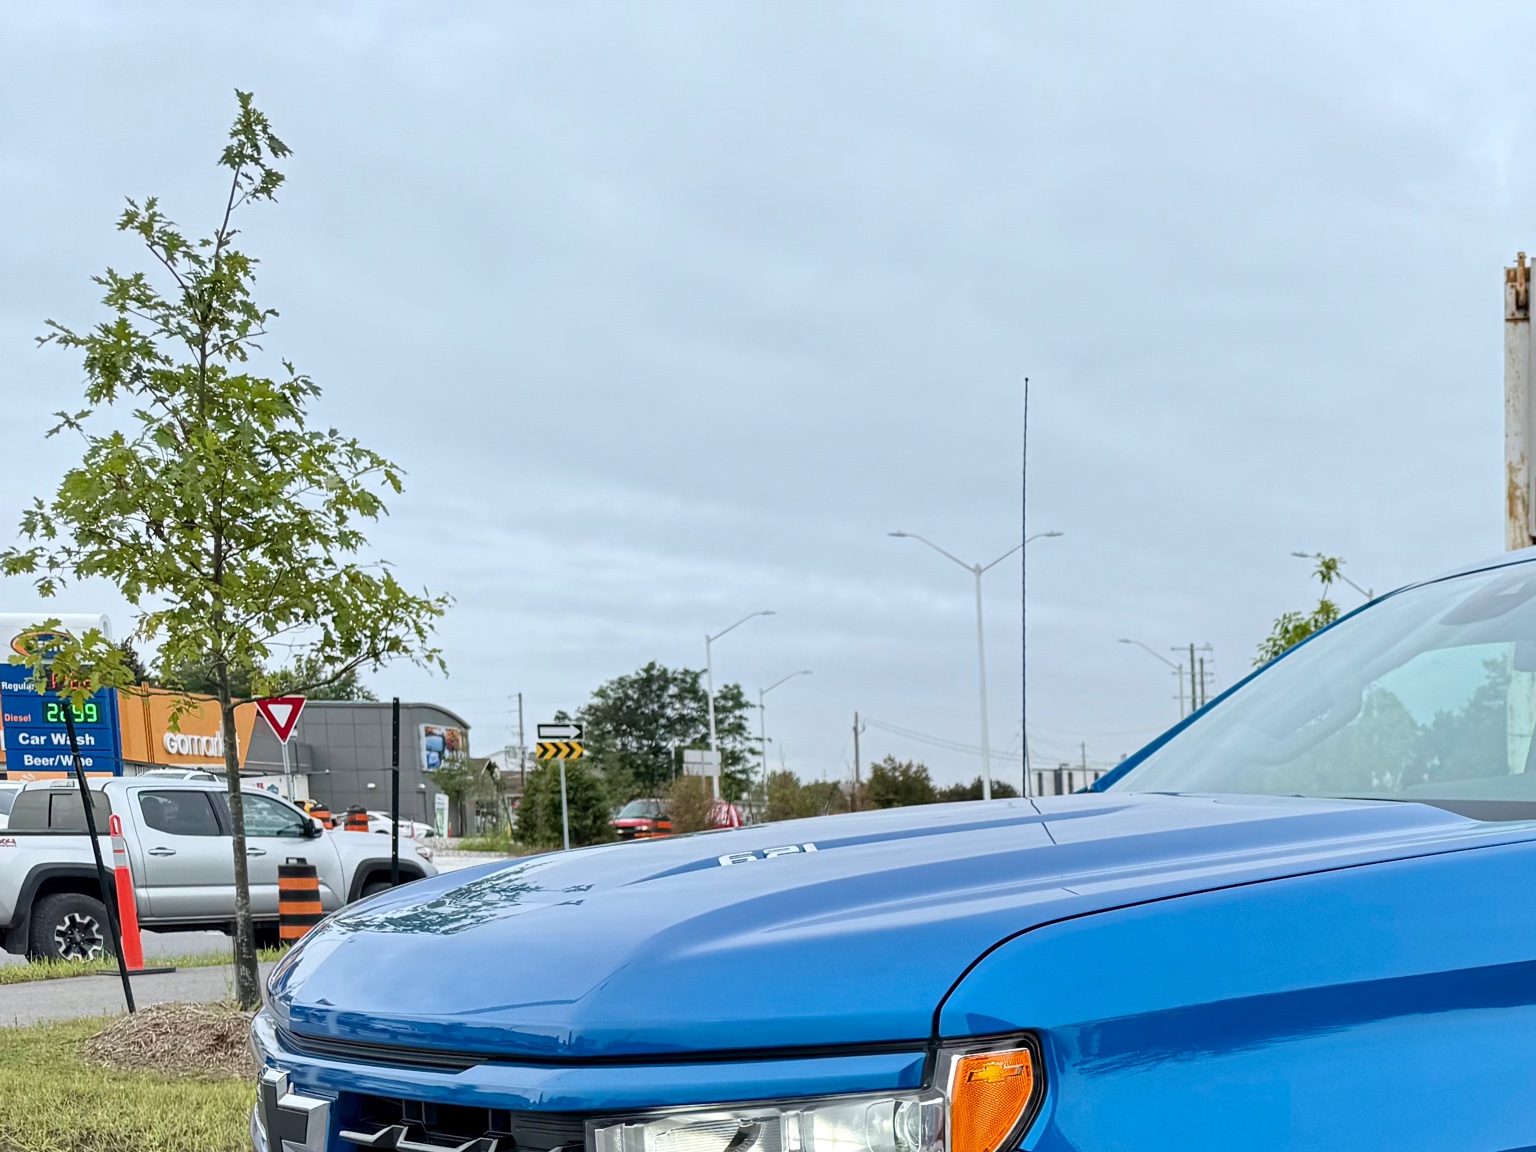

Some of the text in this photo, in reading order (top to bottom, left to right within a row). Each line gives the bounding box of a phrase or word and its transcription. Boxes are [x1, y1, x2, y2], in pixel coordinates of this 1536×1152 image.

[4, 713, 32, 722] Diesel
[18, 732, 47, 745] Car
[23, 754, 93, 767] Beer/Wne
